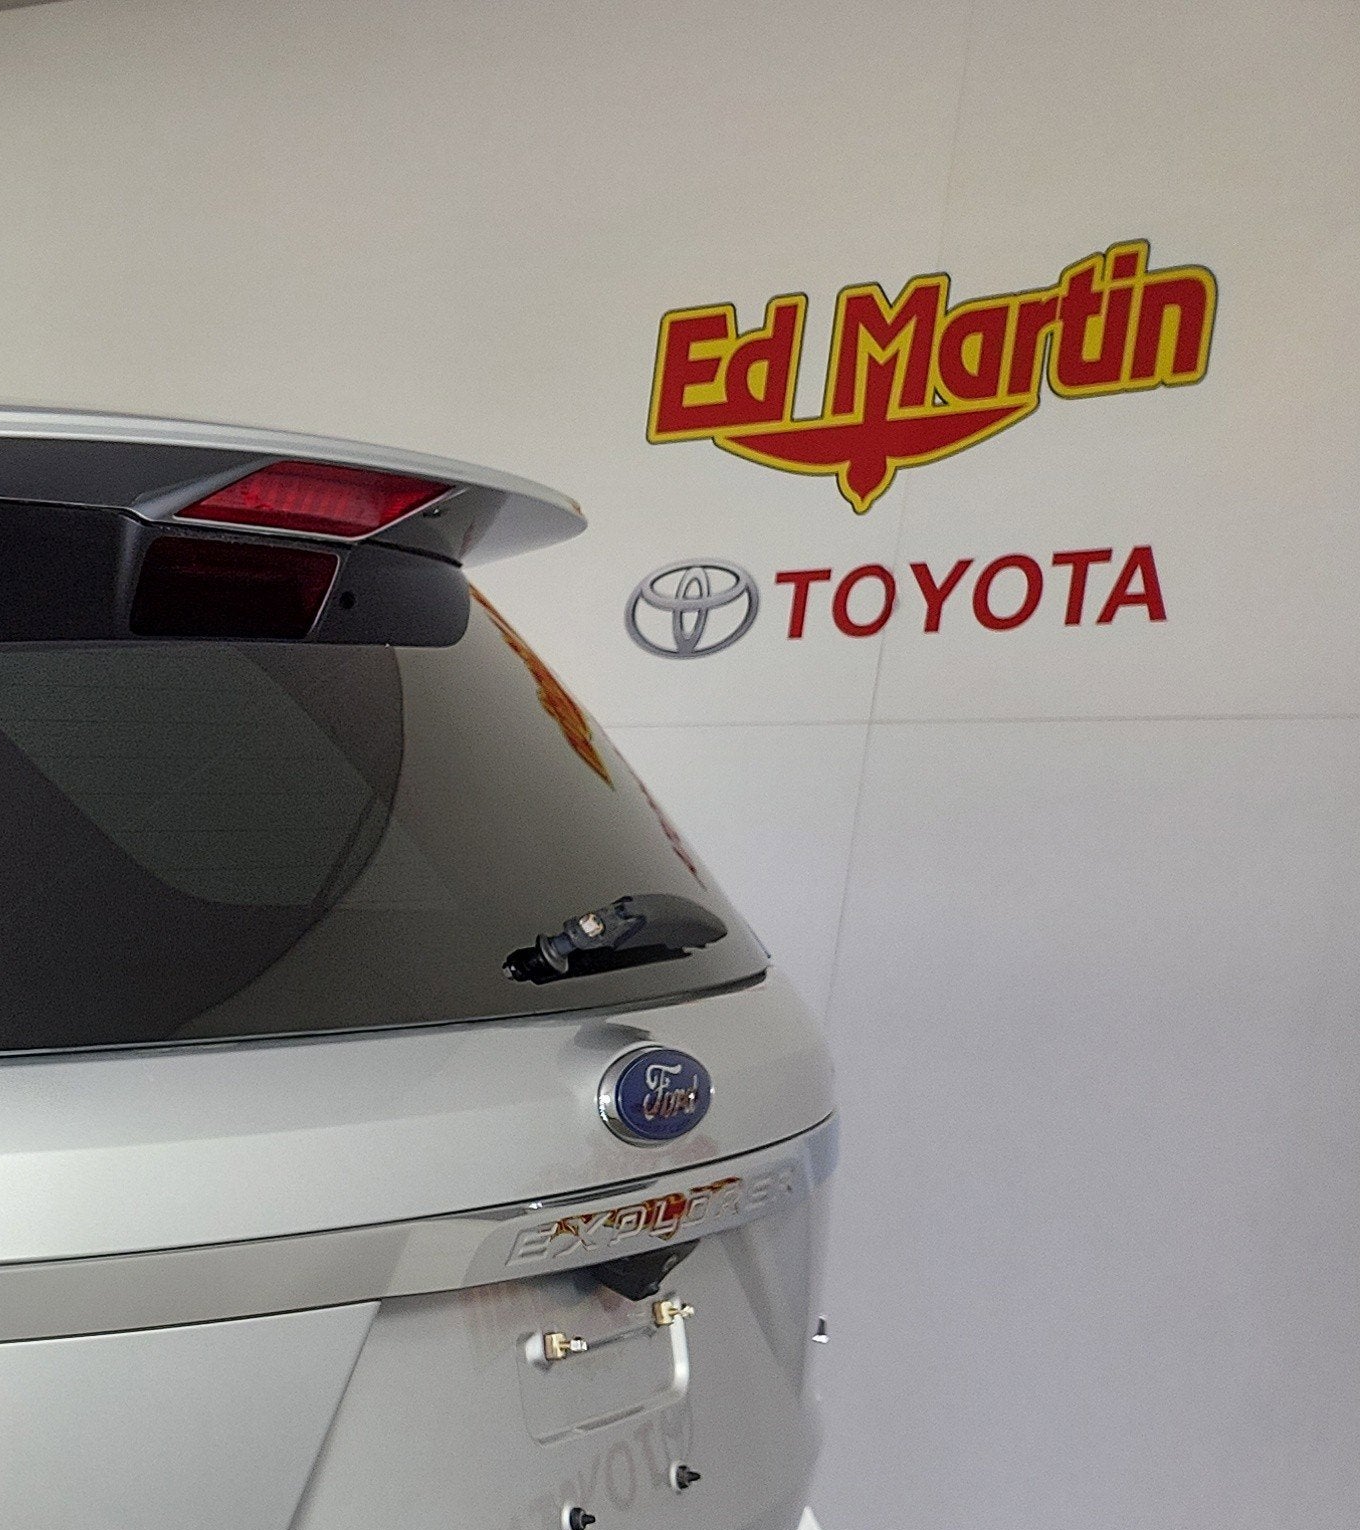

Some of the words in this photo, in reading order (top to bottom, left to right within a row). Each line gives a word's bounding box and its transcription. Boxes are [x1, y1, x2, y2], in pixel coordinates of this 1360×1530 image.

[647, 294, 807, 443] Ed
[828, 240, 1217, 418] Martin
[774, 545, 1168, 640] TOYOTA
[505, 1166, 796, 1266] EXPLORER
